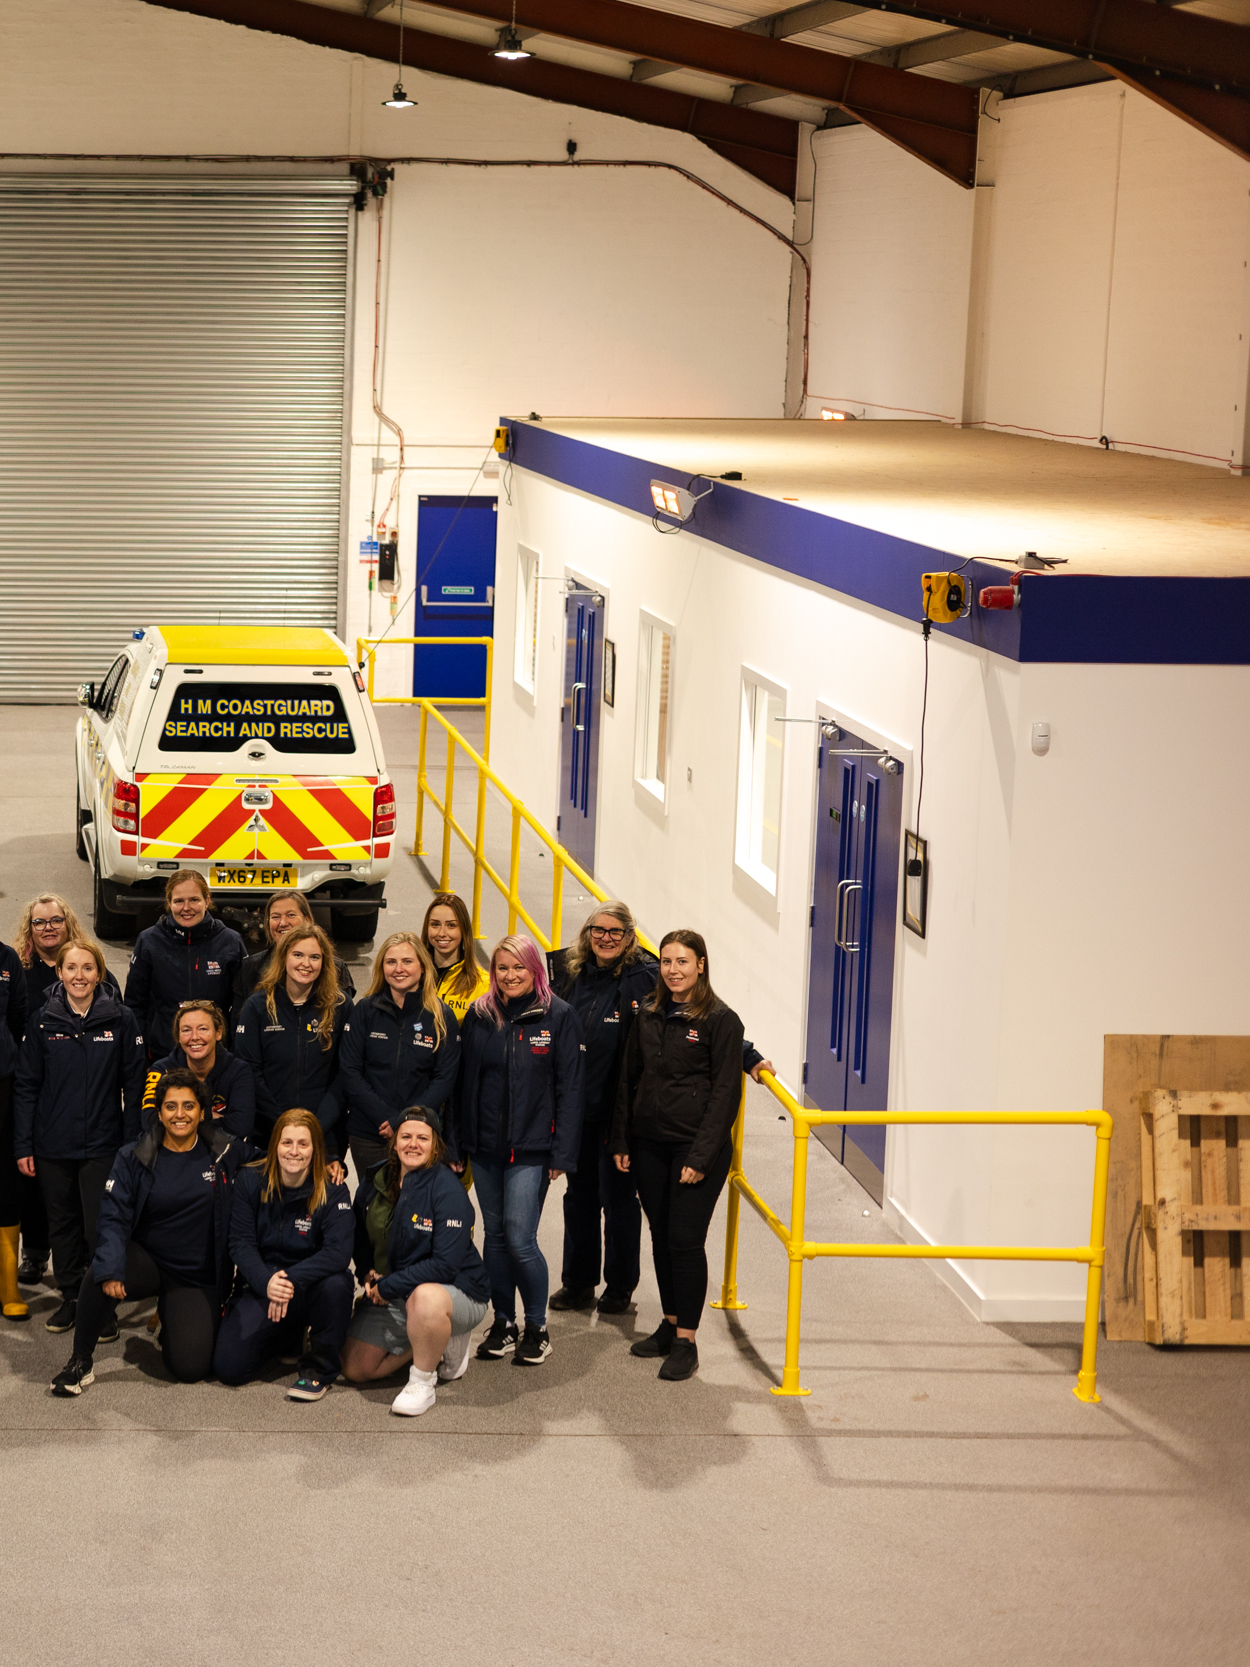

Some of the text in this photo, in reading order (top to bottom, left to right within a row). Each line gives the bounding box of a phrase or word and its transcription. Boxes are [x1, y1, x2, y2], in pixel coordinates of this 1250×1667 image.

[180, 699, 334, 716] H M COASTGUARD
[165, 721, 349, 738] SEARCH AND RESCUE
[261, 870, 290, 884] EPA
[448, 999, 468, 1010] RNL
[141, 1071, 162, 1110] RNLI
[446, 1219, 462, 1228] RNLI
